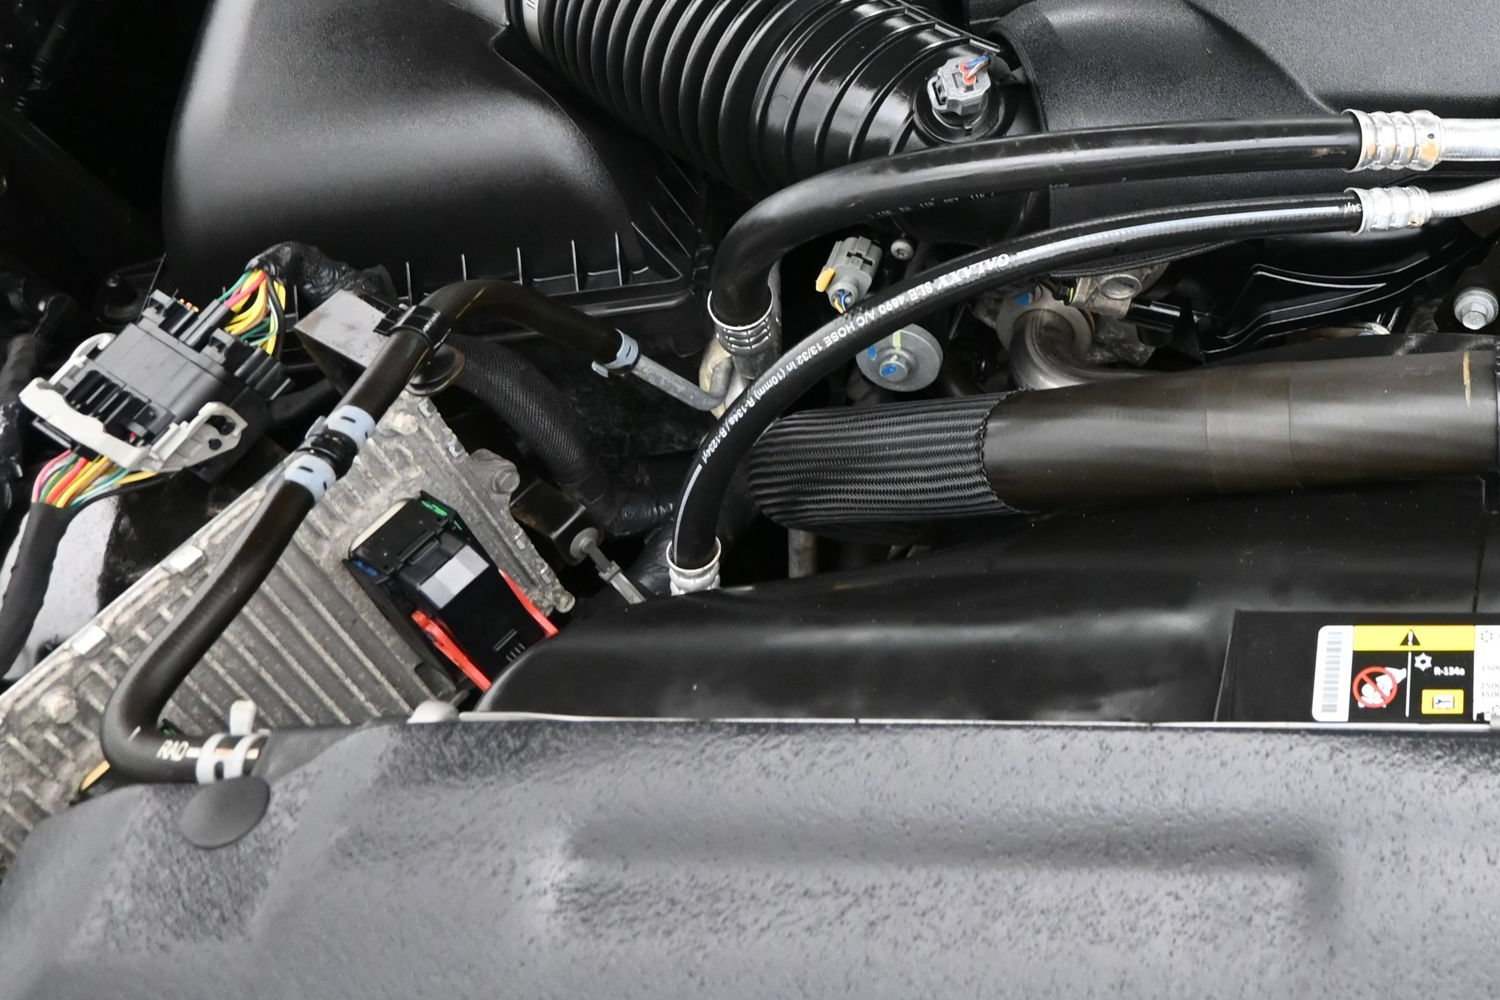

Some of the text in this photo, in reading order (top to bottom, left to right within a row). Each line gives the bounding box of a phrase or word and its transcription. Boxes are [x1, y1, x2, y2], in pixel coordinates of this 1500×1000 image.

[936, 253, 1010, 290] GALAXY
[908, 280, 934, 302] SLE
[856, 309, 875, 327] A/C
[822, 323, 856, 347] HOSE
[796, 342, 823, 365] 13/32
[753, 368, 786, 400] (10mm)
[729, 396, 756, 425] R-134a
[701, 427, 727, 464] R-1234yf
